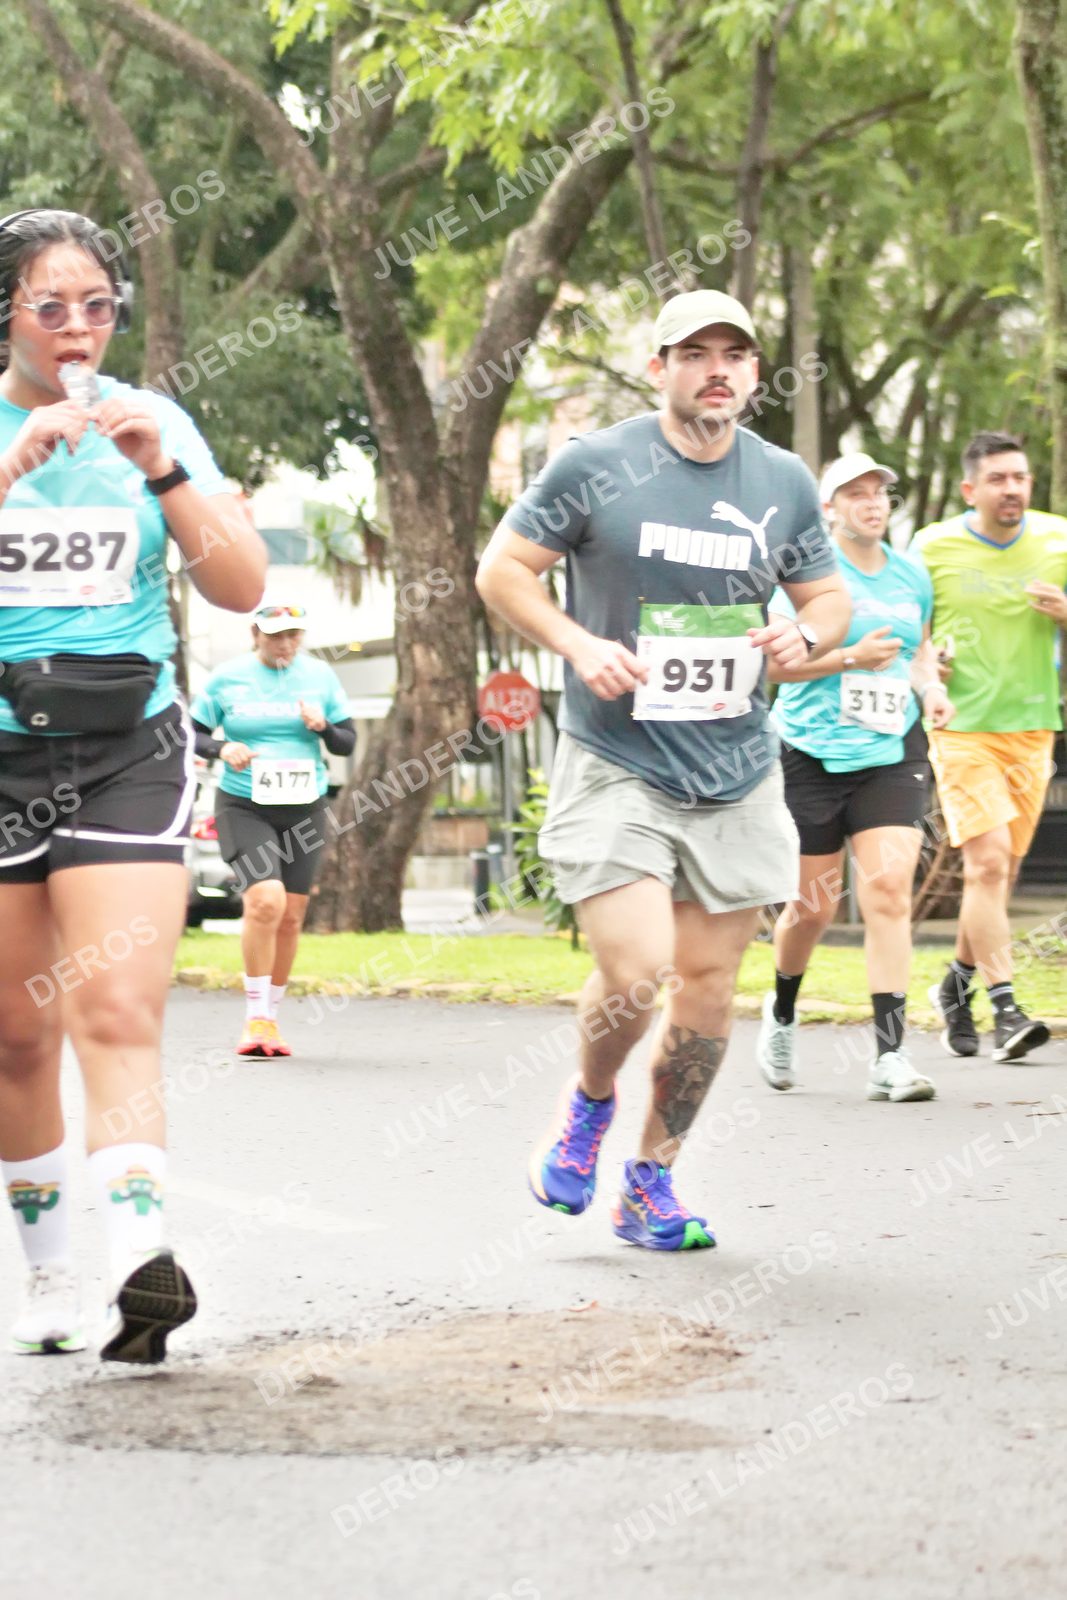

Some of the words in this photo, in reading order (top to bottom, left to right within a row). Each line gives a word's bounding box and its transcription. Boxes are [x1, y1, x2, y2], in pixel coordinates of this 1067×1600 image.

[0, 531, 126, 573] 5287
[638, 521, 752, 571] PUMA
[662, 658, 735, 693] 931
[485, 687, 536, 713] ALTO
[259, 772, 310, 788] 4177
